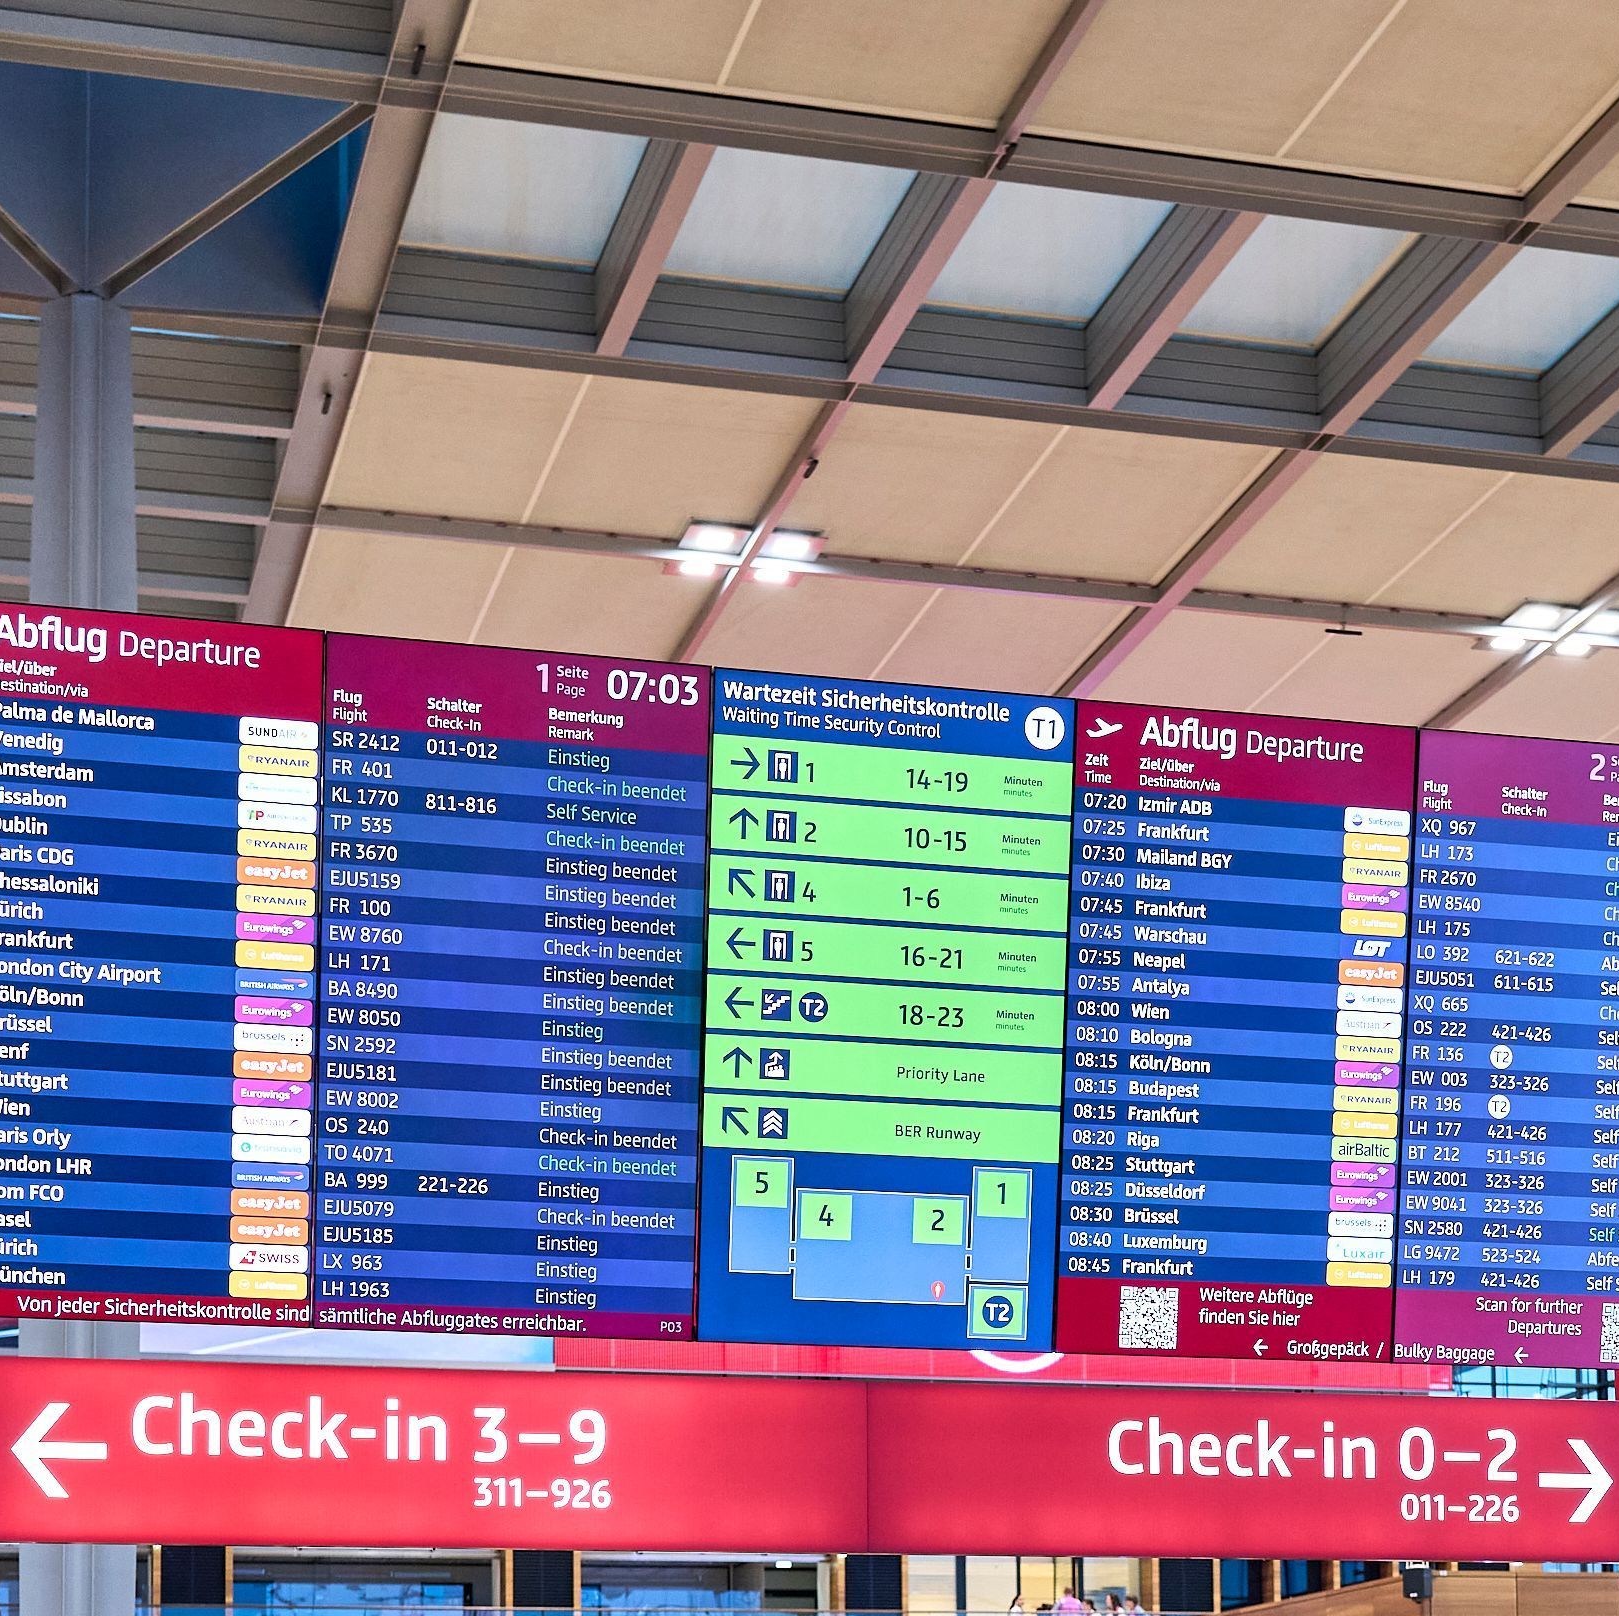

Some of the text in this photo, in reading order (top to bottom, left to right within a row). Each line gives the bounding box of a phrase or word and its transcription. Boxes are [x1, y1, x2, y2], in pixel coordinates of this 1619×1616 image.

[120, 631, 260, 668] Departure
[536, 664, 548, 692] 1
[557, 665, 589, 679] Seite
[557, 683, 585, 699] Page
[608, 669, 698, 705] 07:03
[333, 689, 362, 707] Flug
[723, 681, 1010, 722] Wartezeit Sicherheitskontrolle
[51, 705, 73, 723] de
[78, 709, 154, 730] Mallorca
[333, 707, 367, 724] Flight
[723, 706, 941, 738] Waiting Time Security Control
[1032, 718, 1055, 739] T1
[333, 731, 399, 751] SR 2412
[427, 739, 497, 759] 011-012
[1140, 716, 1363, 762] Abflug Departure
[256, 756, 309, 767] RYANAIR
[549, 748, 609, 772] Einstieg
[806, 763, 814, 782] 1
[906, 769, 968, 792] 14-19
[1004, 776, 1043, 787] Minuten
[1003, 789, 1033, 797] minutes
[1416, 970, 1474, 987] EJU5051
[1494, 975, 1553, 992] 611-615
[802, 999, 824, 1016] T2
[899, 1005, 963, 1028] 18-23
[897, 1066, 985, 1084] Priority Lane
[895, 1125, 981, 1144] BER Runway
[1338, 1142, 1389, 1158] airBaltic
[259, 1253, 299, 1264] SWISS
[1200, 1287, 1313, 1308] Weitere Abflüge
[17, 1296, 586, 1331] Von jeder Sicherheitskontrolle sind sämtliche Abfluggates erreichbar.
[1198, 1308, 1300, 1326] finden Sie hier
[660, 1321, 682, 1332] P03
[1287, 1340, 1495, 1364] Großgepäck Bulky Baggage
[132, 1392, 447, 1461] Check-in
[1109, 1417, 1375, 1478] Check-in
